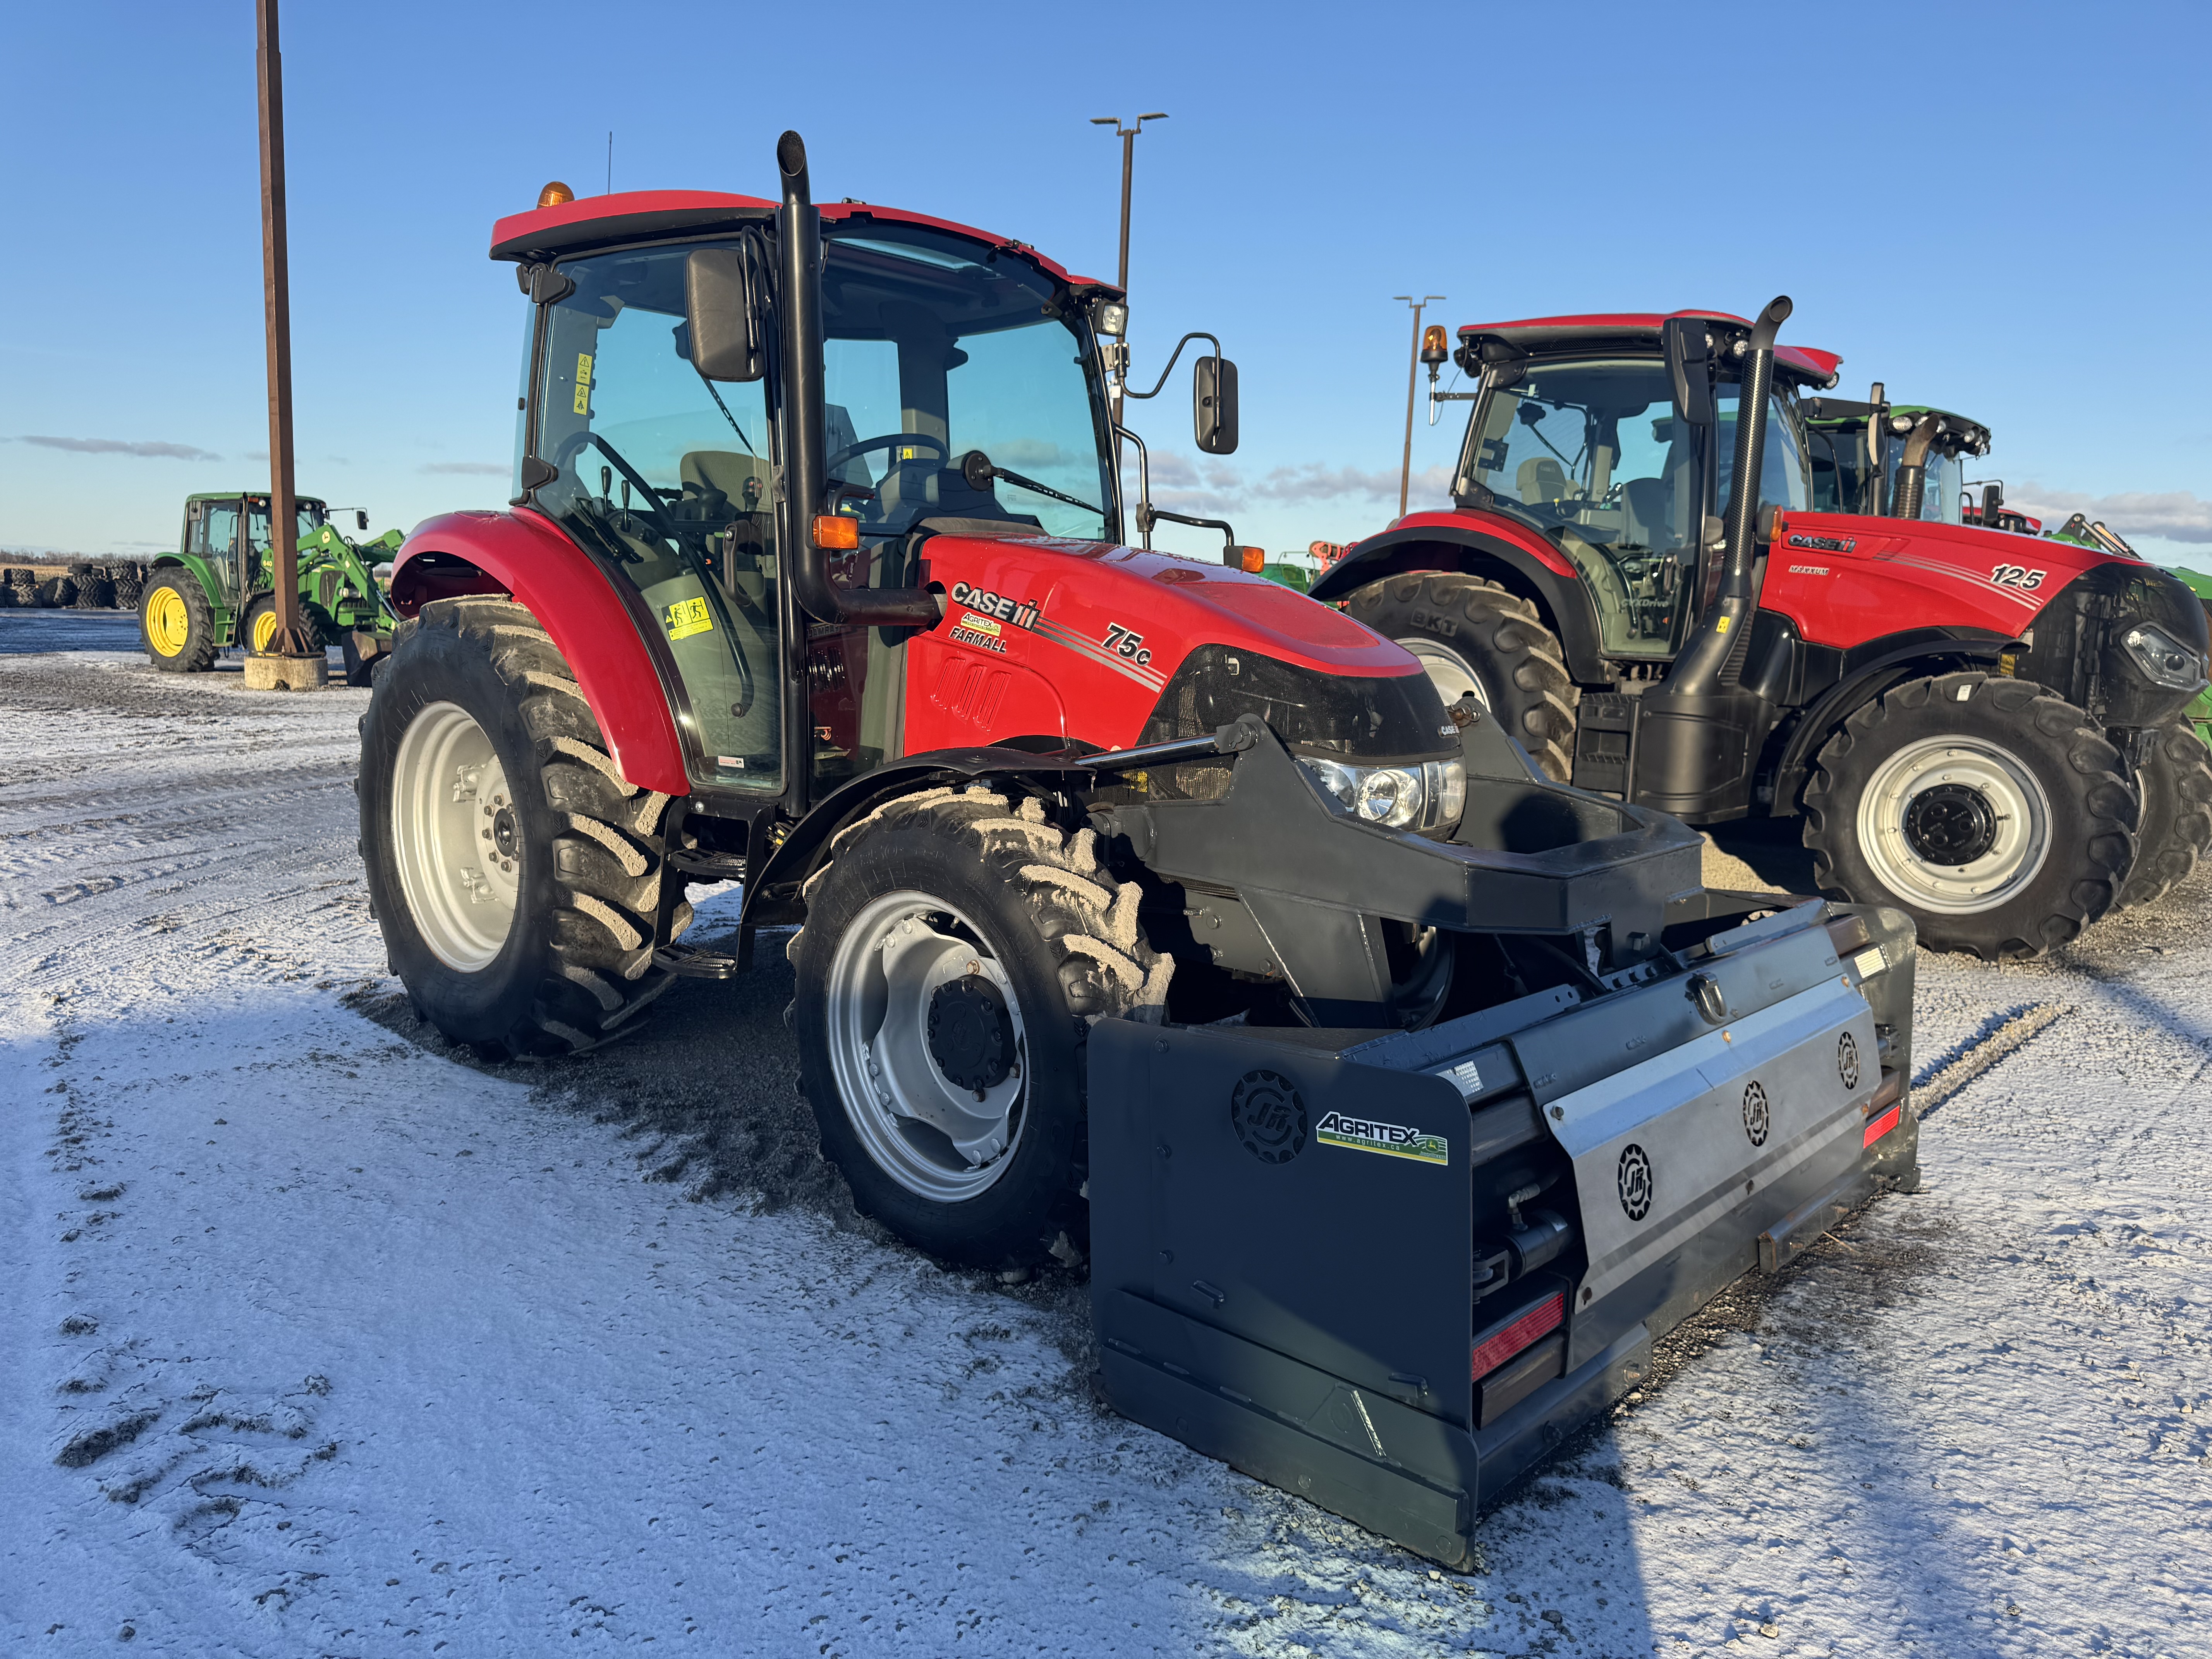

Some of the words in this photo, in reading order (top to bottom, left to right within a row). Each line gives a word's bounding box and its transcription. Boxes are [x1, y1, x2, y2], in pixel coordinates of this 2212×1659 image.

[1788, 534, 1839, 550] CASE
[1788, 565, 1830, 576] MAXXUM
[1990, 563, 2047, 591] 125
[951, 581, 1017, 620] CASE
[963, 613, 992, 627] AGRITEX
[1410, 608, 1459, 637] BKT
[949, 626, 1006, 654] FARMALL
[1441, 725, 1455, 735] CASE
[1844, 1050, 1853, 1071] JR
[1246, 1103, 1292, 1132] JR
[1750, 1100, 1763, 1125] JR
[1318, 1114, 1418, 1146] AGRITEX
[1336, 1134, 1400, 1151] www.agritex.ca
[1626, 1166, 1644, 1197] JR
